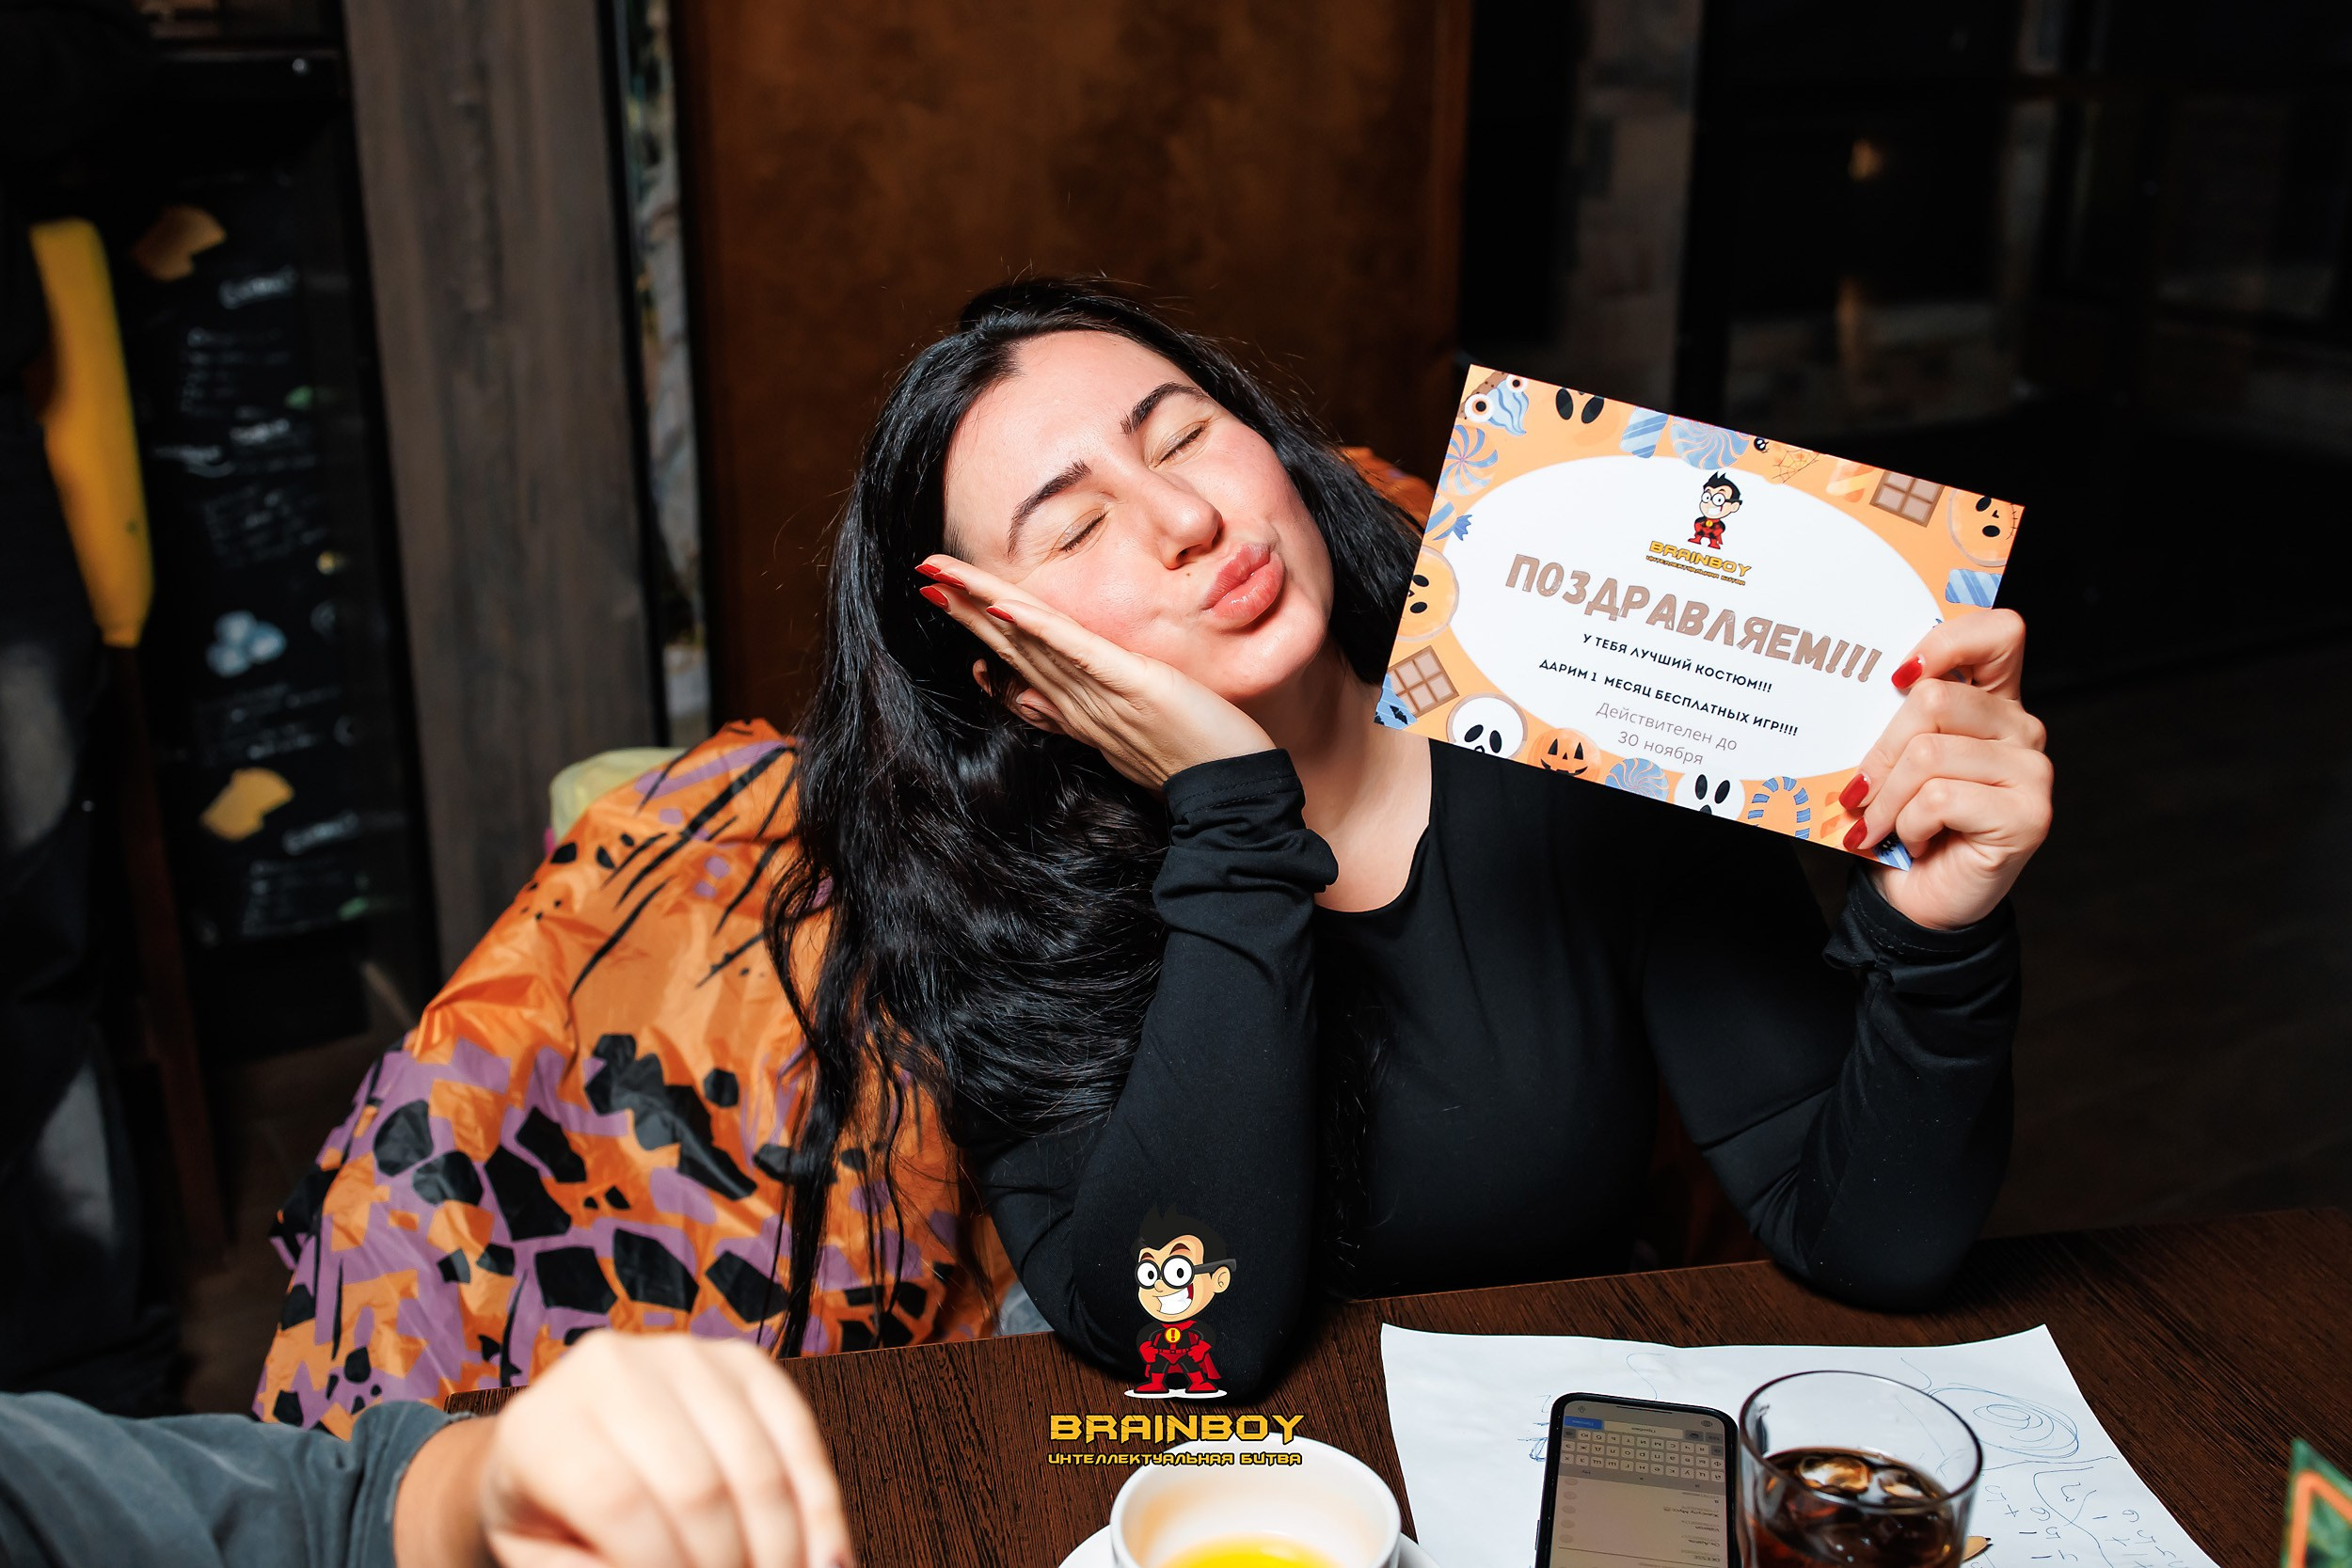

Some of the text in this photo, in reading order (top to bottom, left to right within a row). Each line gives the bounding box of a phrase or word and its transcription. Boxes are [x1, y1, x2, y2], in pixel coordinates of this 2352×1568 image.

[1648, 540, 1752, 578] BRAINBOY
[1505, 553, 1883, 683] ПОЗДРАВЛЯЕМ!!!
[1583, 633, 1772, 693] У ТЕБЯ ЛУЧШИЙ КОСТЮМ!!!
[1538, 658, 1799, 736] ДАРИМ 1 МЕСЯЦ БЕСПЛАТНЫХ ИГР!!!!
[1595, 702, 1738, 752] Действителен до
[1617, 731, 1704, 765] 30 ноября
